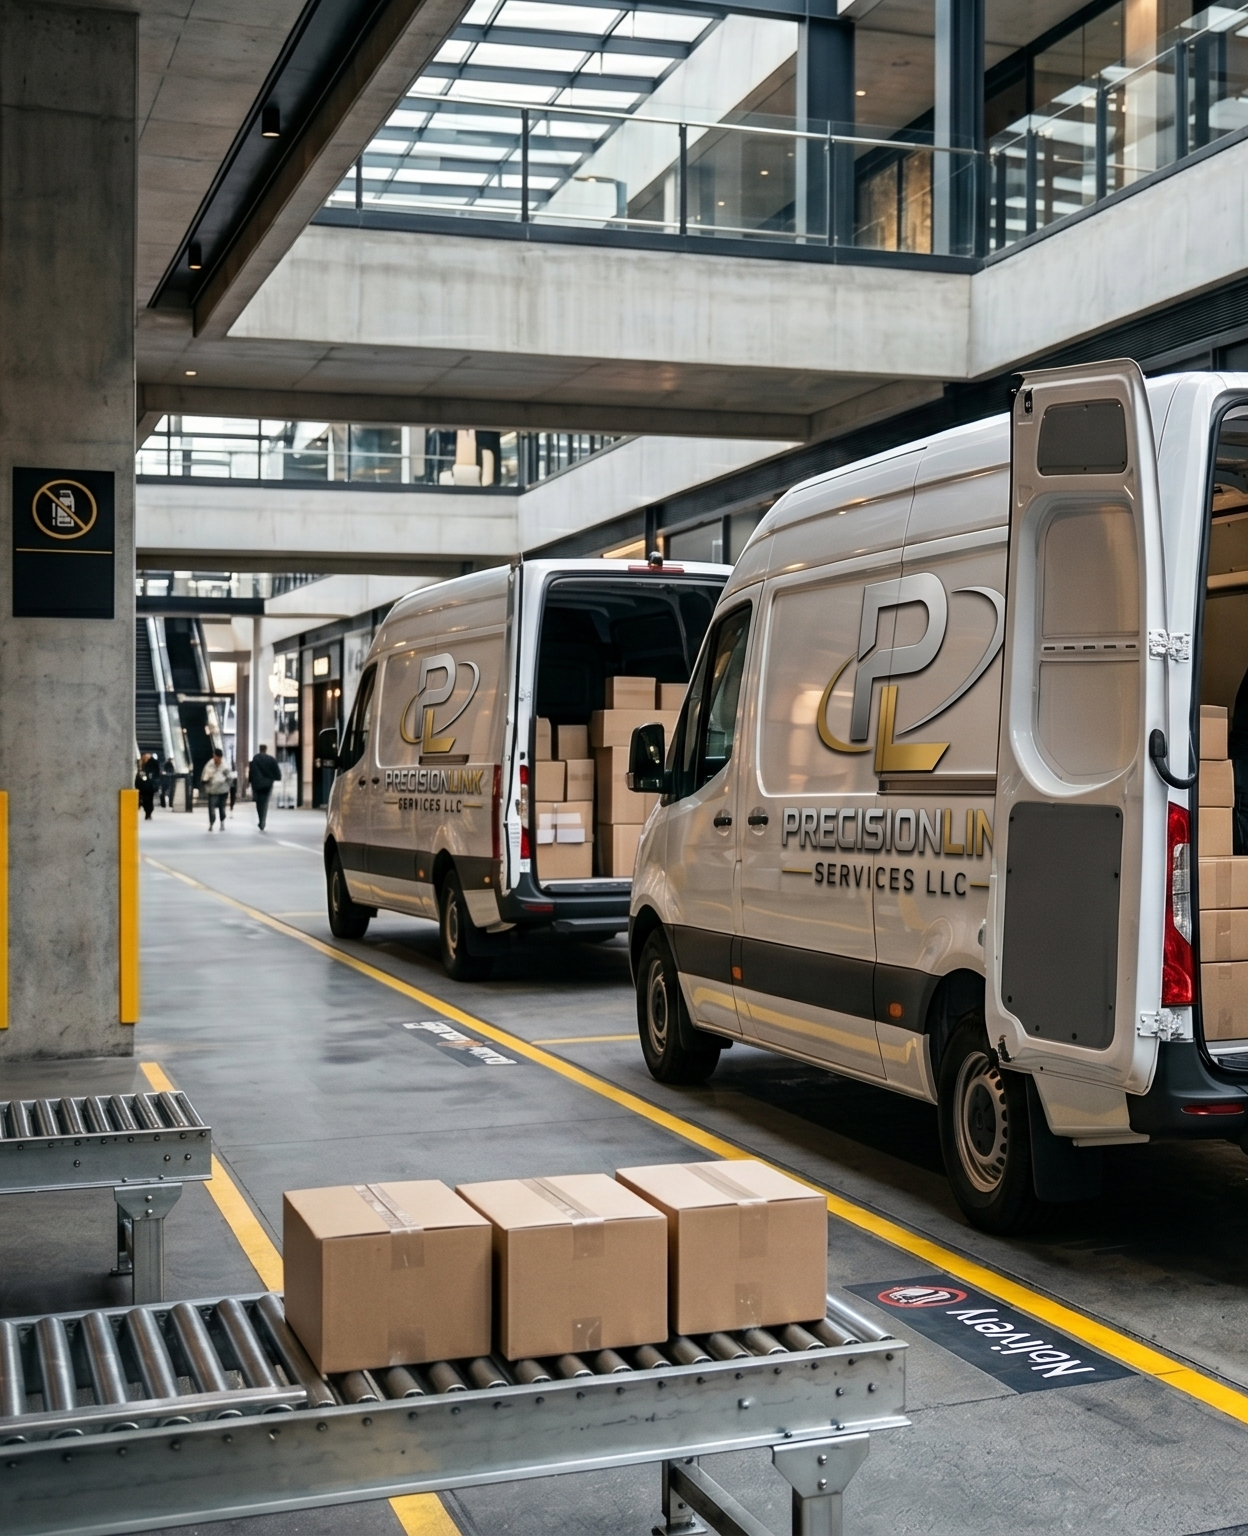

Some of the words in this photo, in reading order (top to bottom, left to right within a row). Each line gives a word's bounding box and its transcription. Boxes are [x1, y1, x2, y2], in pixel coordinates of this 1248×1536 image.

[851, 572, 950, 773] PL
[384, 769, 485, 795] PRECISIONLINK
[398, 797, 441, 812] SERVICES
[444, 800, 462, 813] LLC
[781, 807, 994, 856] PRECISIONLIN
[814, 862, 914, 892] SERVICES
[926, 870, 967, 896] LLC
